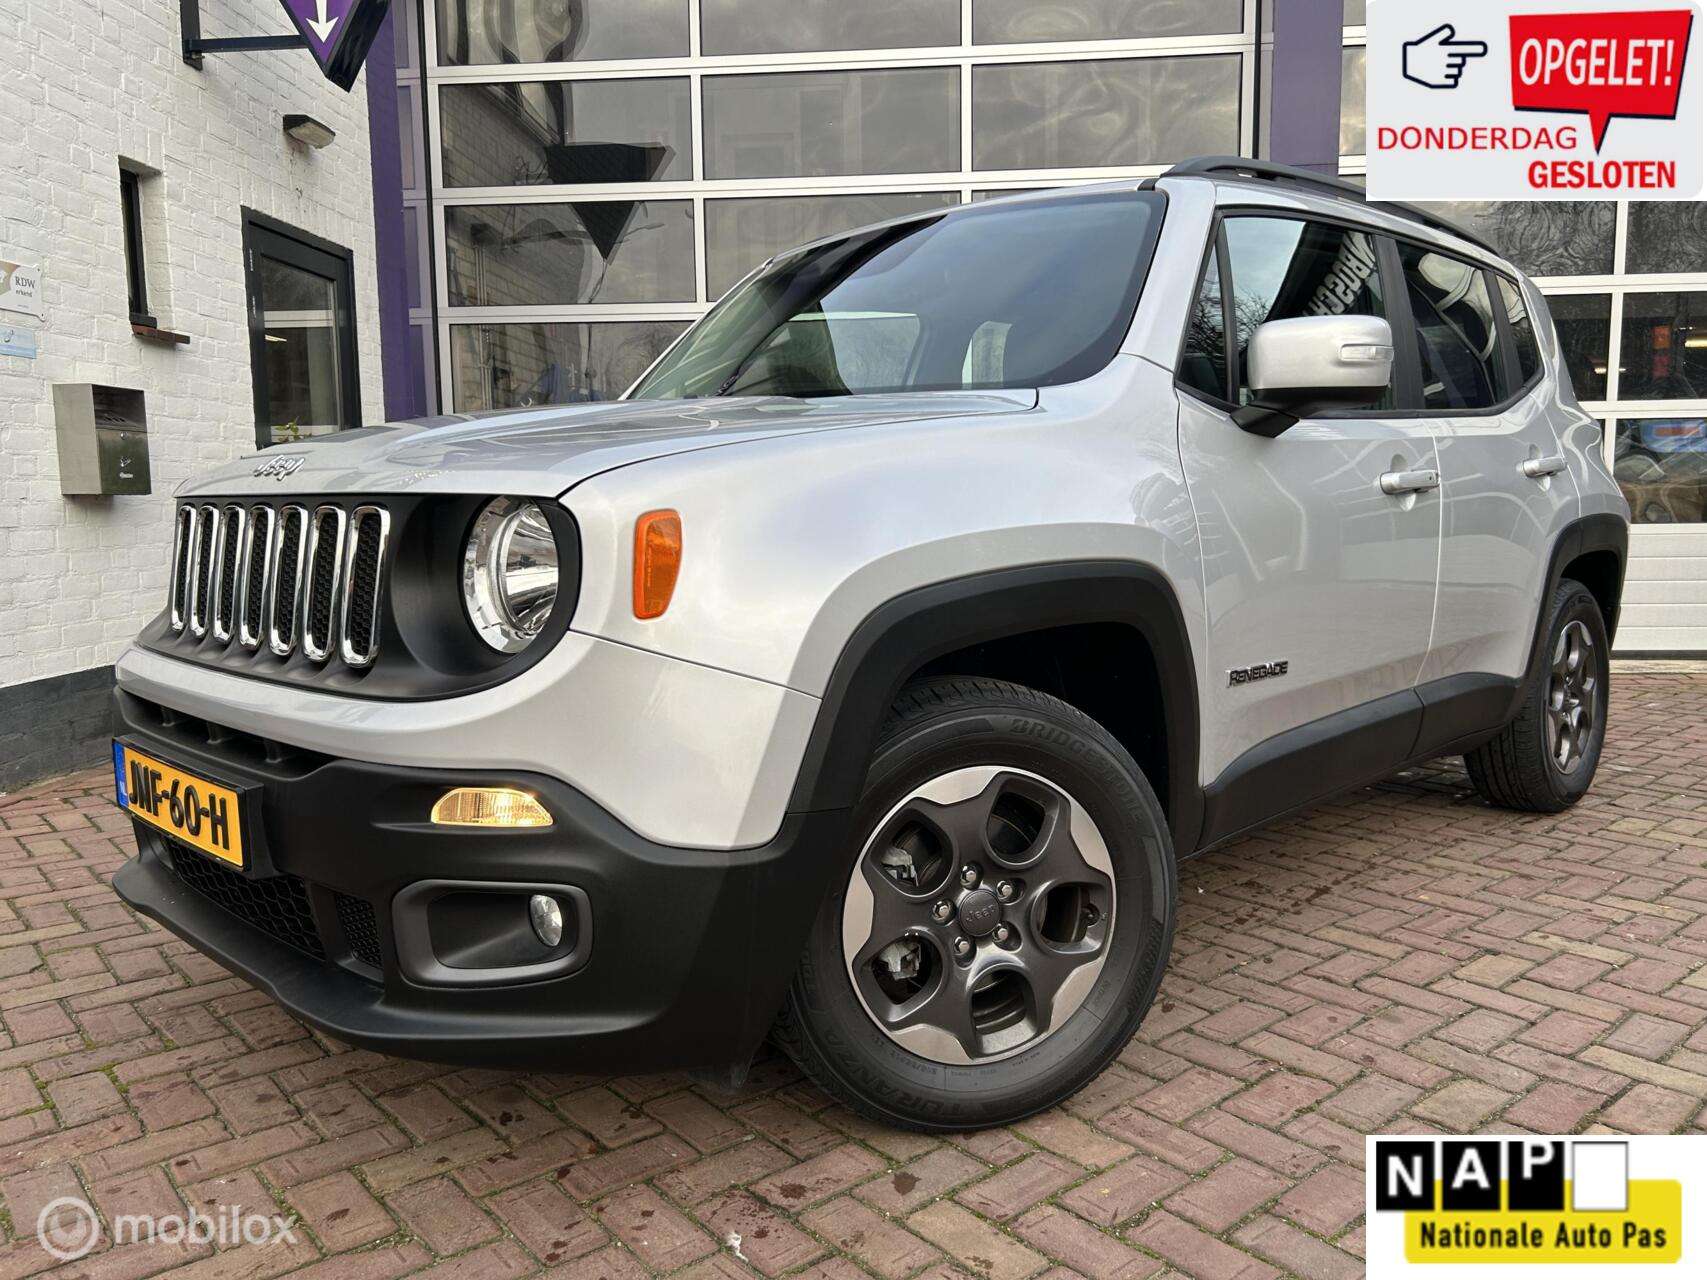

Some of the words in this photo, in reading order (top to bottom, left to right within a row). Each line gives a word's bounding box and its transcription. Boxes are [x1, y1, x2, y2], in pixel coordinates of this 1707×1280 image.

[15, 276, 36, 288] RDW
[1226, 660, 1289, 688] RENEGADE
[128, 759, 231, 851] JNF-60-H
